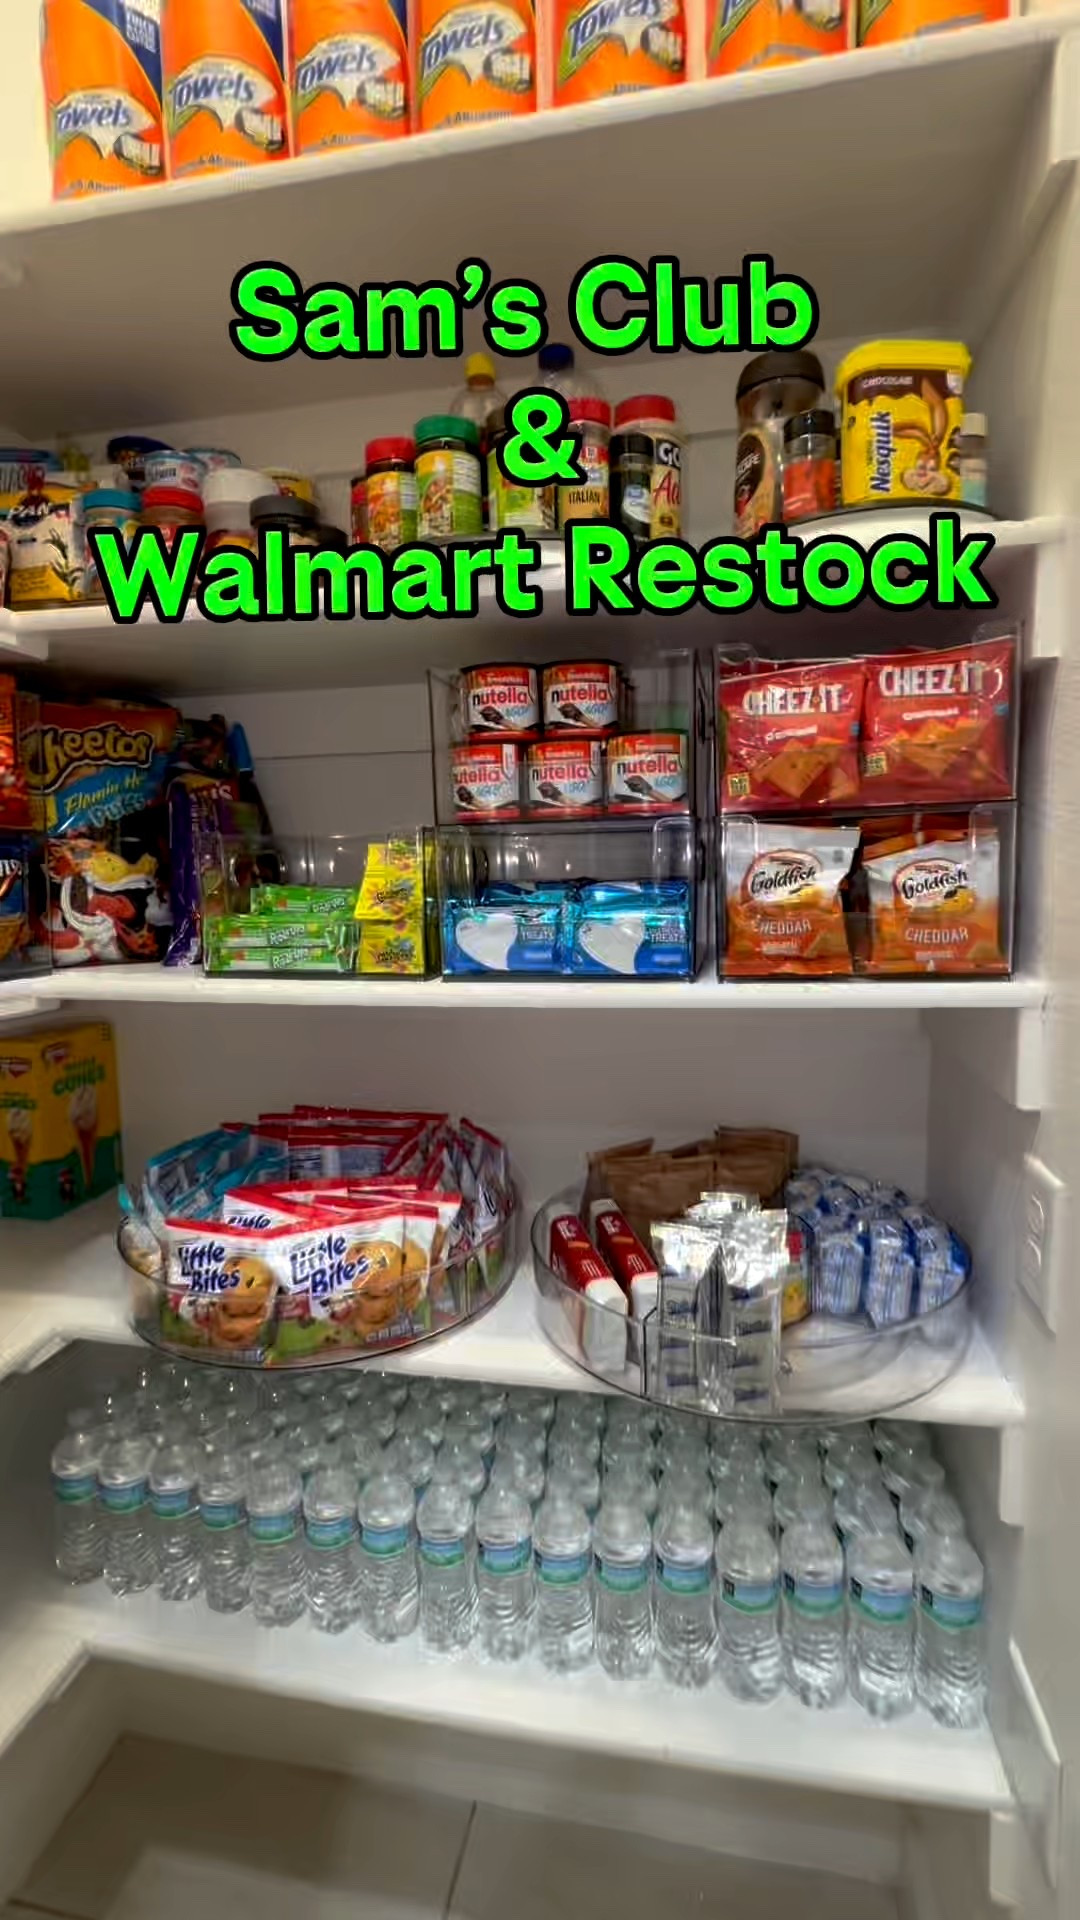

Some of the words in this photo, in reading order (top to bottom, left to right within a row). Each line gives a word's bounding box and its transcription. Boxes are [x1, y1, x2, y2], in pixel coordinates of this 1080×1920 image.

[869, 411, 898, 492] Nesquik
[568, 489, 601, 505] ITALIAN
[472, 686, 528, 706] nutella
[551, 683, 608, 703] nutella
[22, 726, 152, 787] Cheetos
[617, 755, 678, 775] nutella
[453, 765, 500, 784] utella
[532, 762, 588, 781] nutella
[751, 865, 817, 894] Goldfish
[902, 869, 968, 899] Goldfish
[904, 926, 969, 944] CHEDDAR
[178, 1240, 226, 1277] Little
[189, 1268, 241, 1294] Bites
[311, 1255, 369, 1294] Bites
